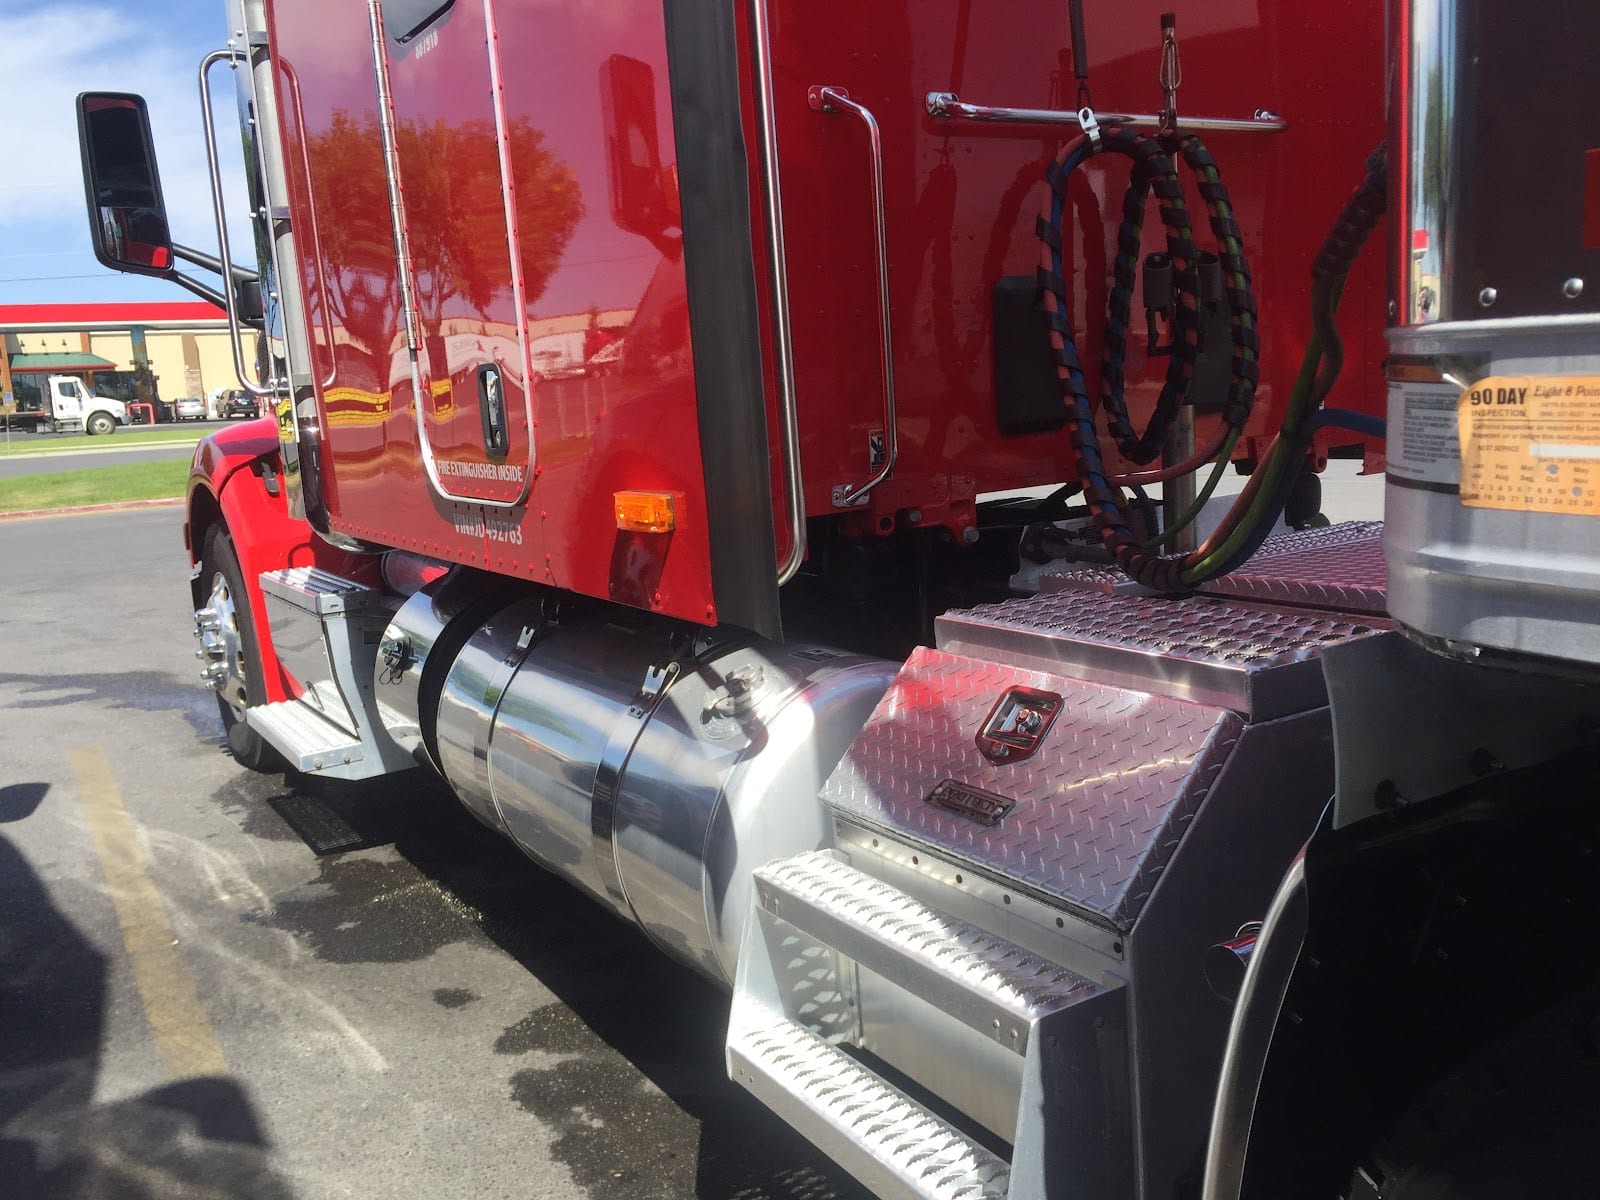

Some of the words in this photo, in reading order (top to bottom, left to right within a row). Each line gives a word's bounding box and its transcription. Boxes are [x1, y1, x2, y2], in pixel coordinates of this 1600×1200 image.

[1471, 388, 1493, 406] 90
[1496, 387, 1527, 405] DAY
[1534, 385, 1563, 399] Eight
[1471, 408, 1527, 417] INSPECTION
[437, 460, 451, 476] FIRE
[450, 461, 498, 481] EXTINGUISHER
[498, 464, 523, 483] INSIDE
[1573, 466, 1589, 474] May
[1494, 473, 1509, 482] Aug
[1524, 496, 1534, 504] 22
[486, 520, 523, 545] 492763
